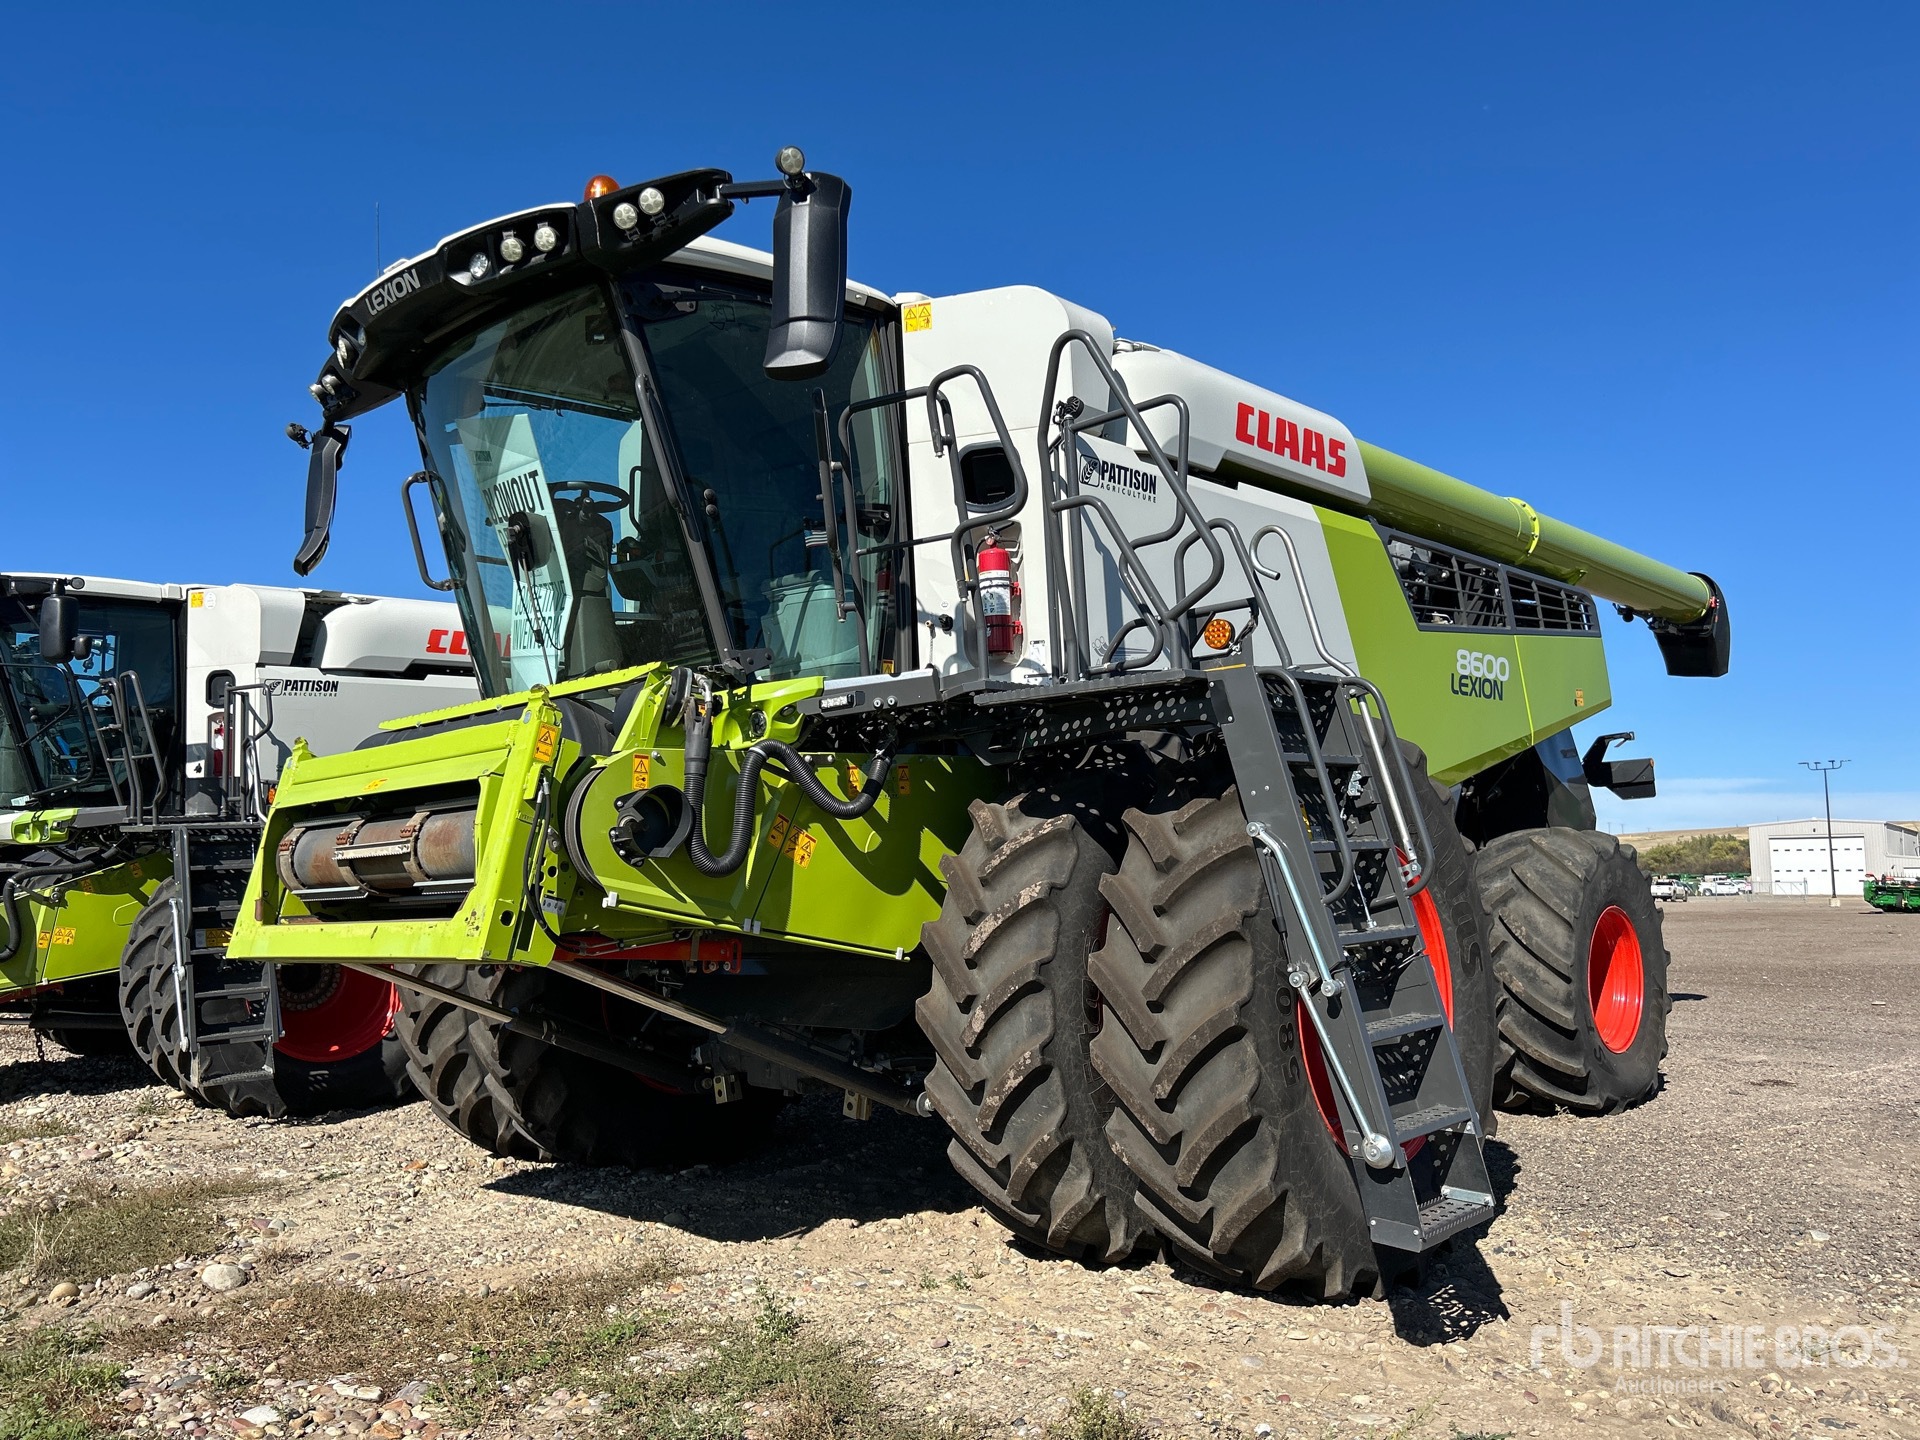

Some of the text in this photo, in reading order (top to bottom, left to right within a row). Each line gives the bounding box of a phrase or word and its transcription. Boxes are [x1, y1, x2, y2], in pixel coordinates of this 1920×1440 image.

[365, 268, 421, 316] LEXION
[1235, 401, 1346, 478] CLAAS
[1100, 482, 1157, 503] AGRICULTURE
[1101, 460, 1157, 495] PATTISON
[483, 469, 545, 525] BLOWOUT
[1456, 649, 1510, 682] 8600
[284, 680, 339, 692] PATTISON
[1451, 673, 1504, 702] LEXION
